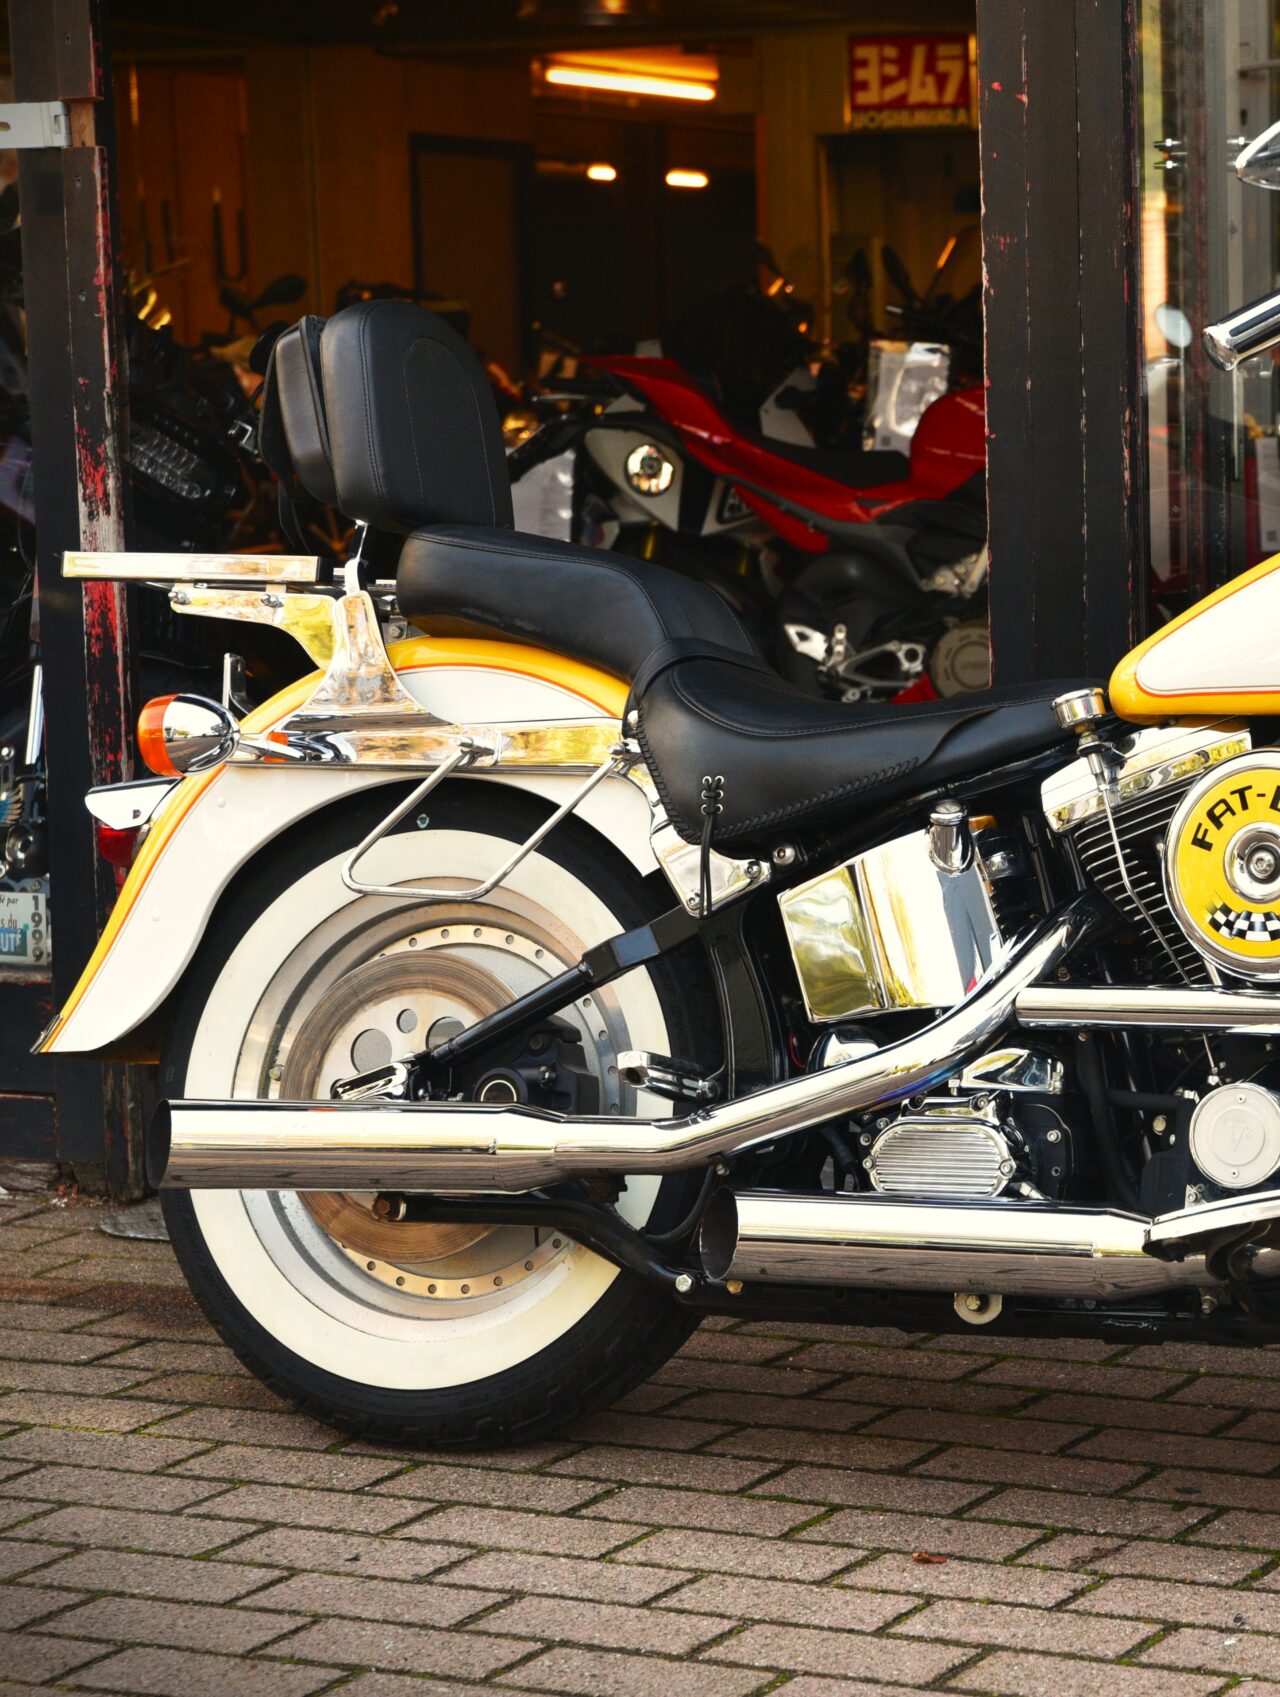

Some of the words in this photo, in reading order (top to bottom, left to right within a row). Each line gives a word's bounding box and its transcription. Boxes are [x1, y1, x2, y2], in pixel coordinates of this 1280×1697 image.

[853, 44, 964, 104] ヨシムラ
[31, 895, 44, 962] 1999
